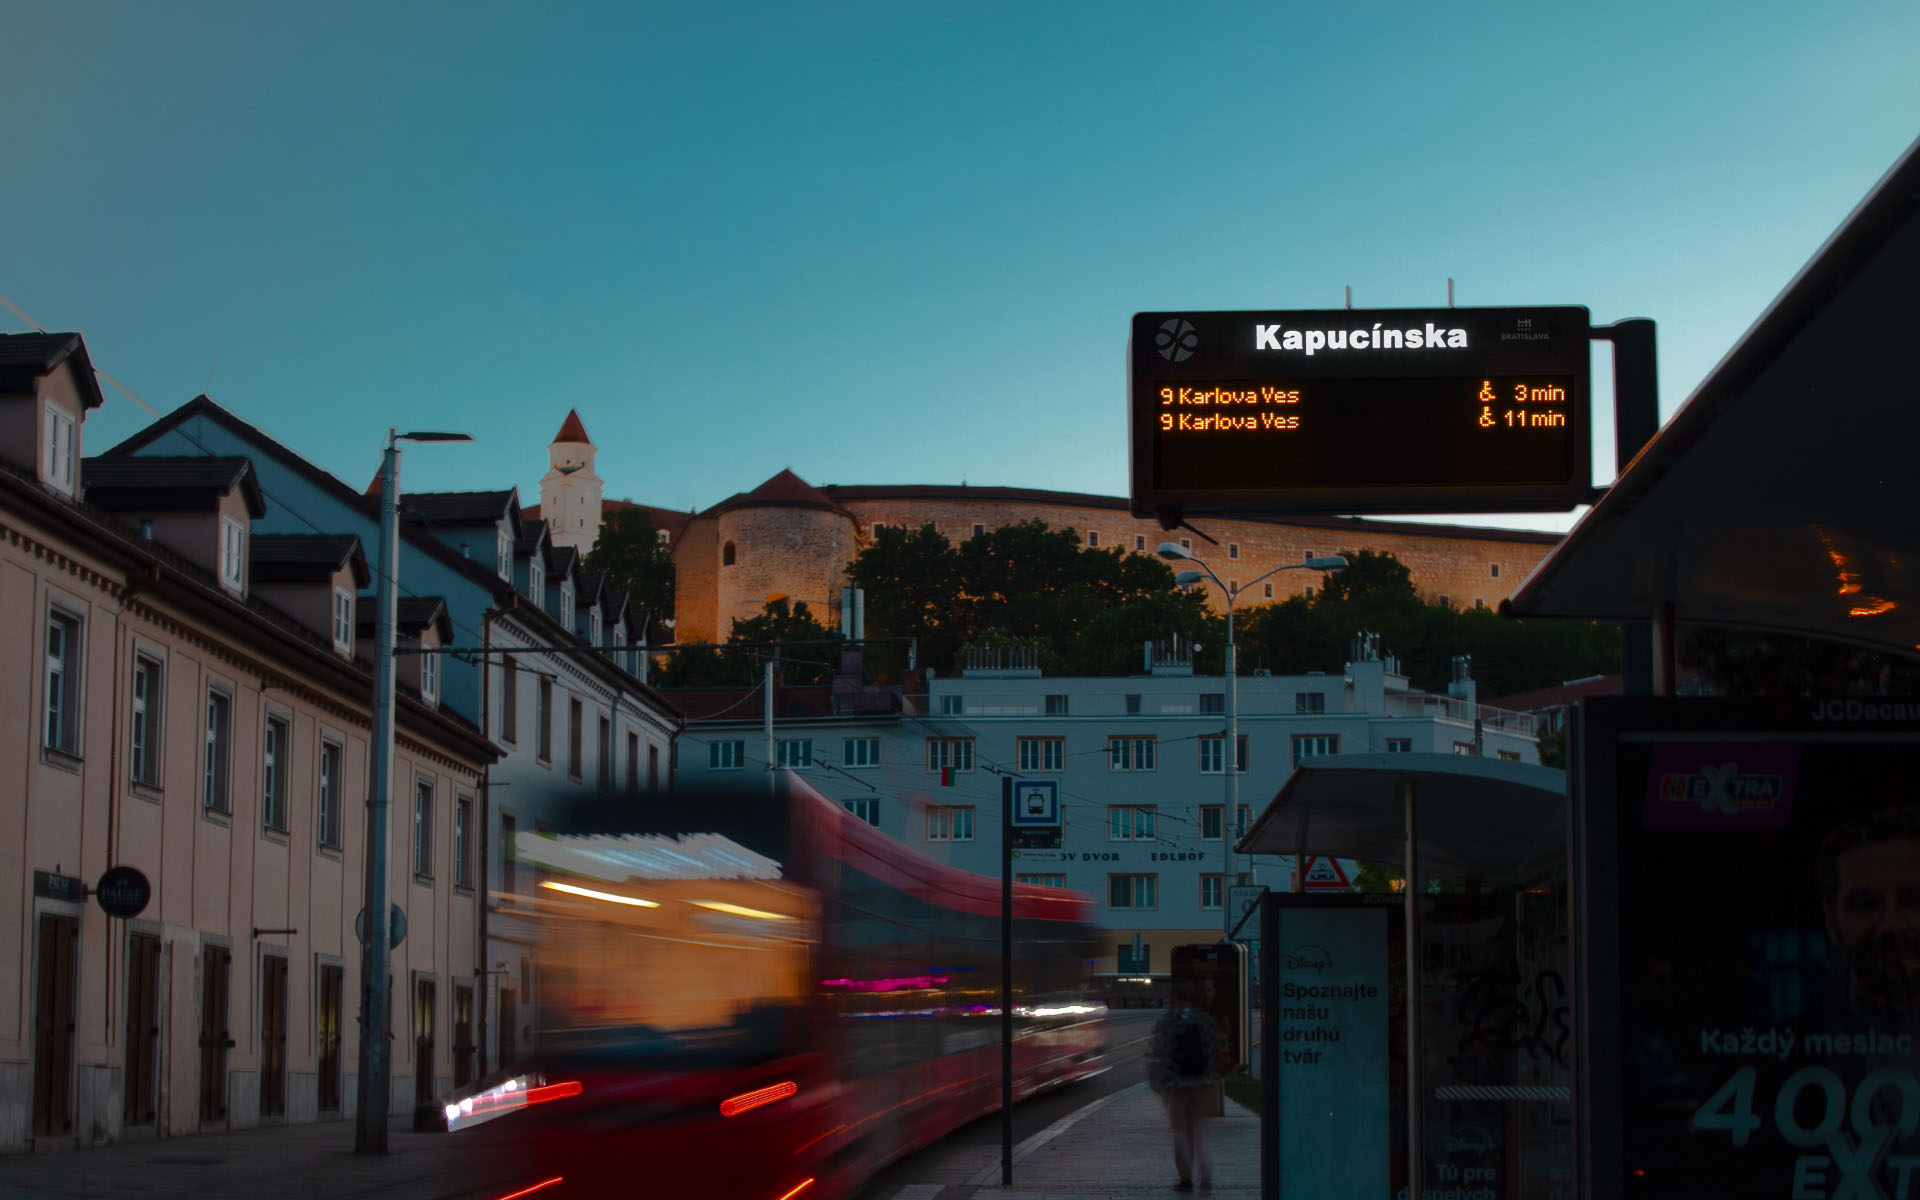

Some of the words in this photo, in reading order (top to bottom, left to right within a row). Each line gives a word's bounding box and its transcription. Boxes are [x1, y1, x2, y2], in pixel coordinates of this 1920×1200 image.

[1255, 323, 1468, 355] Kapucínska
[1500, 333, 1550, 341] BRATISLAVA
[1160, 388, 1173, 404] 9
[1179, 387, 1257, 404] Karlova
[1261, 387, 1299, 403] Ves
[1514, 384, 1527, 401] 3
[1532, 384, 1566, 401] min
[1160, 413, 1173, 430] 9
[1179, 413, 1257, 430] Karlova
[1261, 412, 1299, 429] Ves
[1504, 410, 1525, 427] 11
[1532, 410, 1566, 427] min
[1082, 852, 1121, 862] DVOR
[1151, 852, 1205, 862] EDLHOF
[1283, 981, 1378, 1002] Spoznajte
[1283, 1004, 1329, 1020] našu
[1283, 1025, 1340, 1042] druhú
[1700, 1025, 1794, 1060] Každý
[1803, 1028, 1913, 1056] mesiac
[1283, 1047, 1322, 1064] tvár
[1434, 1162, 1459, 1181] Tú
[1463, 1166, 1497, 1185] pre
[1396, 1184, 1496, 1200] dspelých
